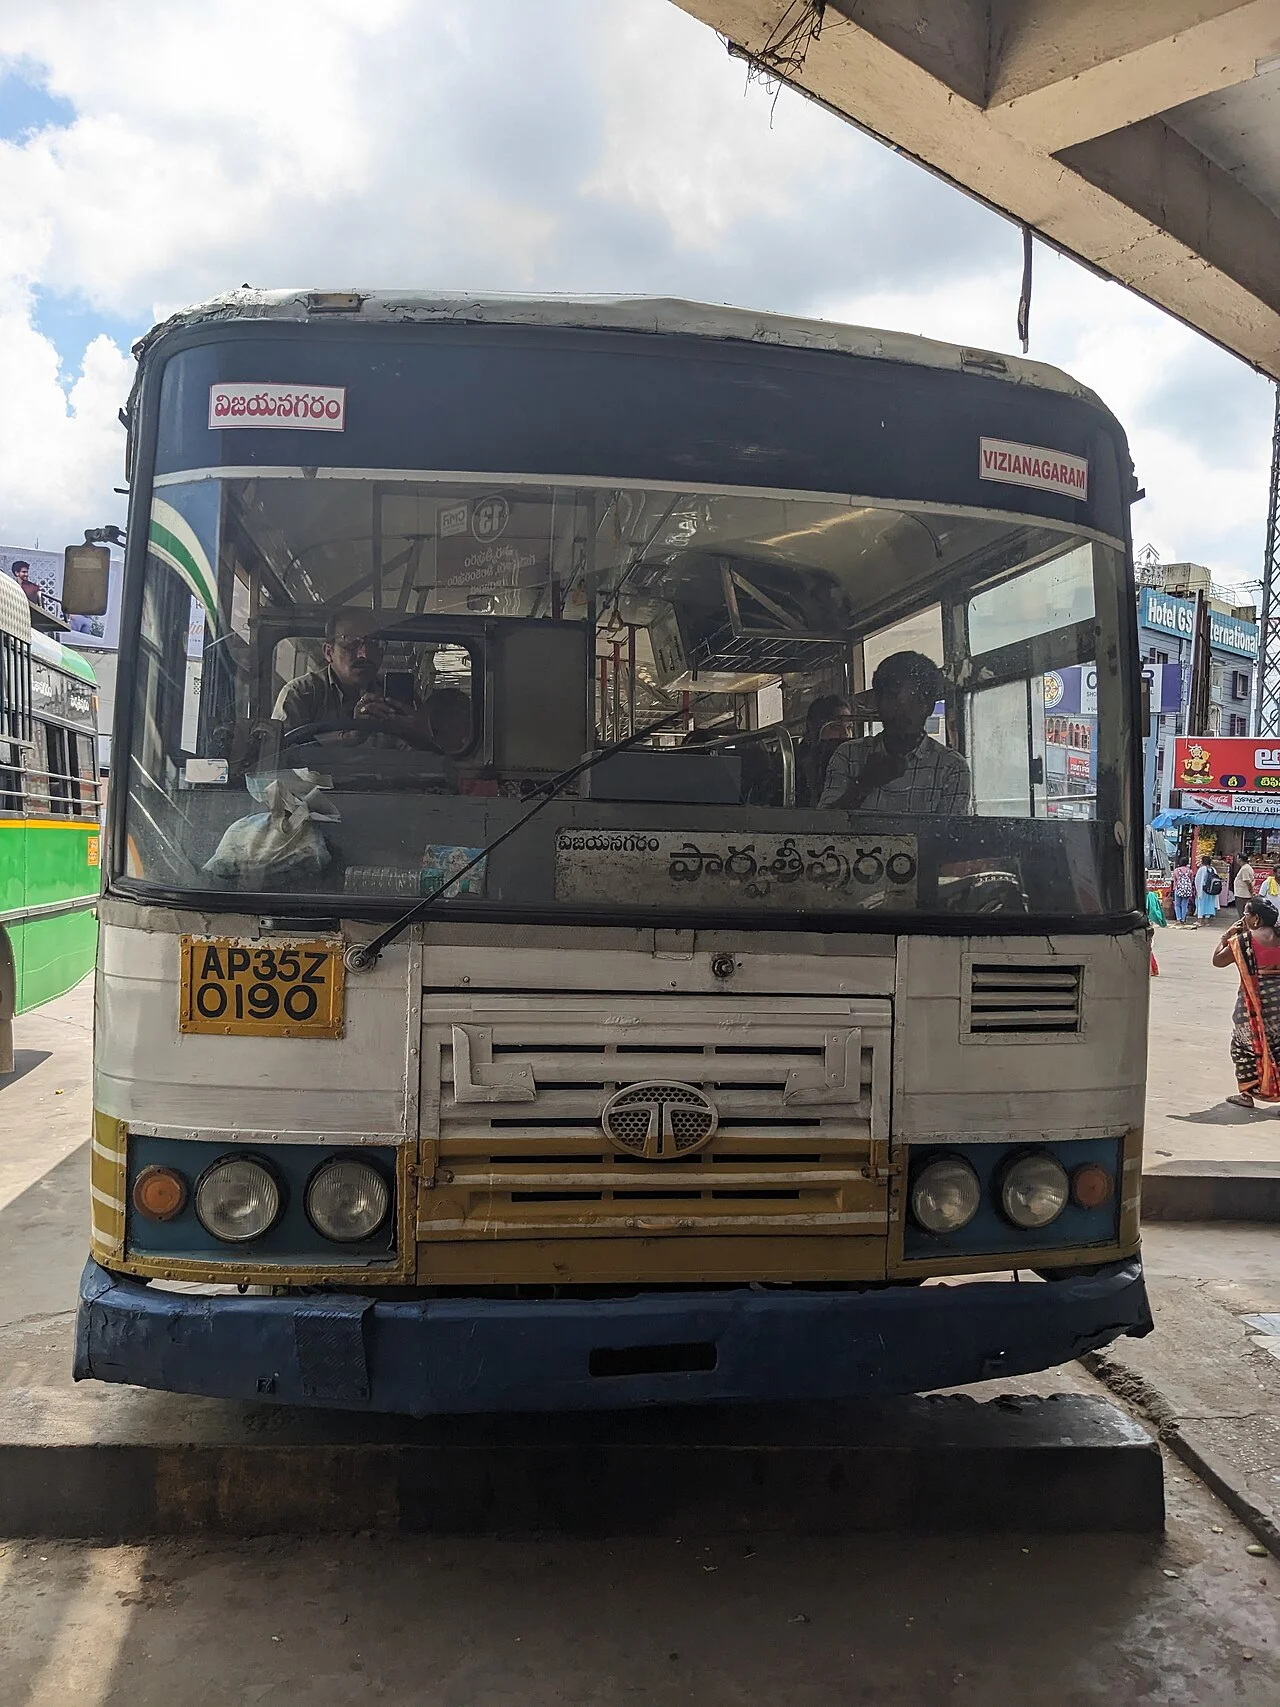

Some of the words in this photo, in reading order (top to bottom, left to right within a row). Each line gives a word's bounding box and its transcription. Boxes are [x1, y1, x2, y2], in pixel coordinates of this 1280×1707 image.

[214, 392, 341, 420] విజయనగరం
[983, 449, 1085, 489] VIZIANAGARAM
[1148, 597, 1176, 629] Hotel
[1178, 606, 1194, 635] GS
[1210, 617, 1261, 654] ternational
[1234, 805, 1262, 813] HOTEL
[558, 835, 660, 853] విజయనగరం
[668, 838, 917, 898] పార్వతీపురం
[200, 945, 328, 984] AP35Z
[197, 982, 318, 1021] 0190
